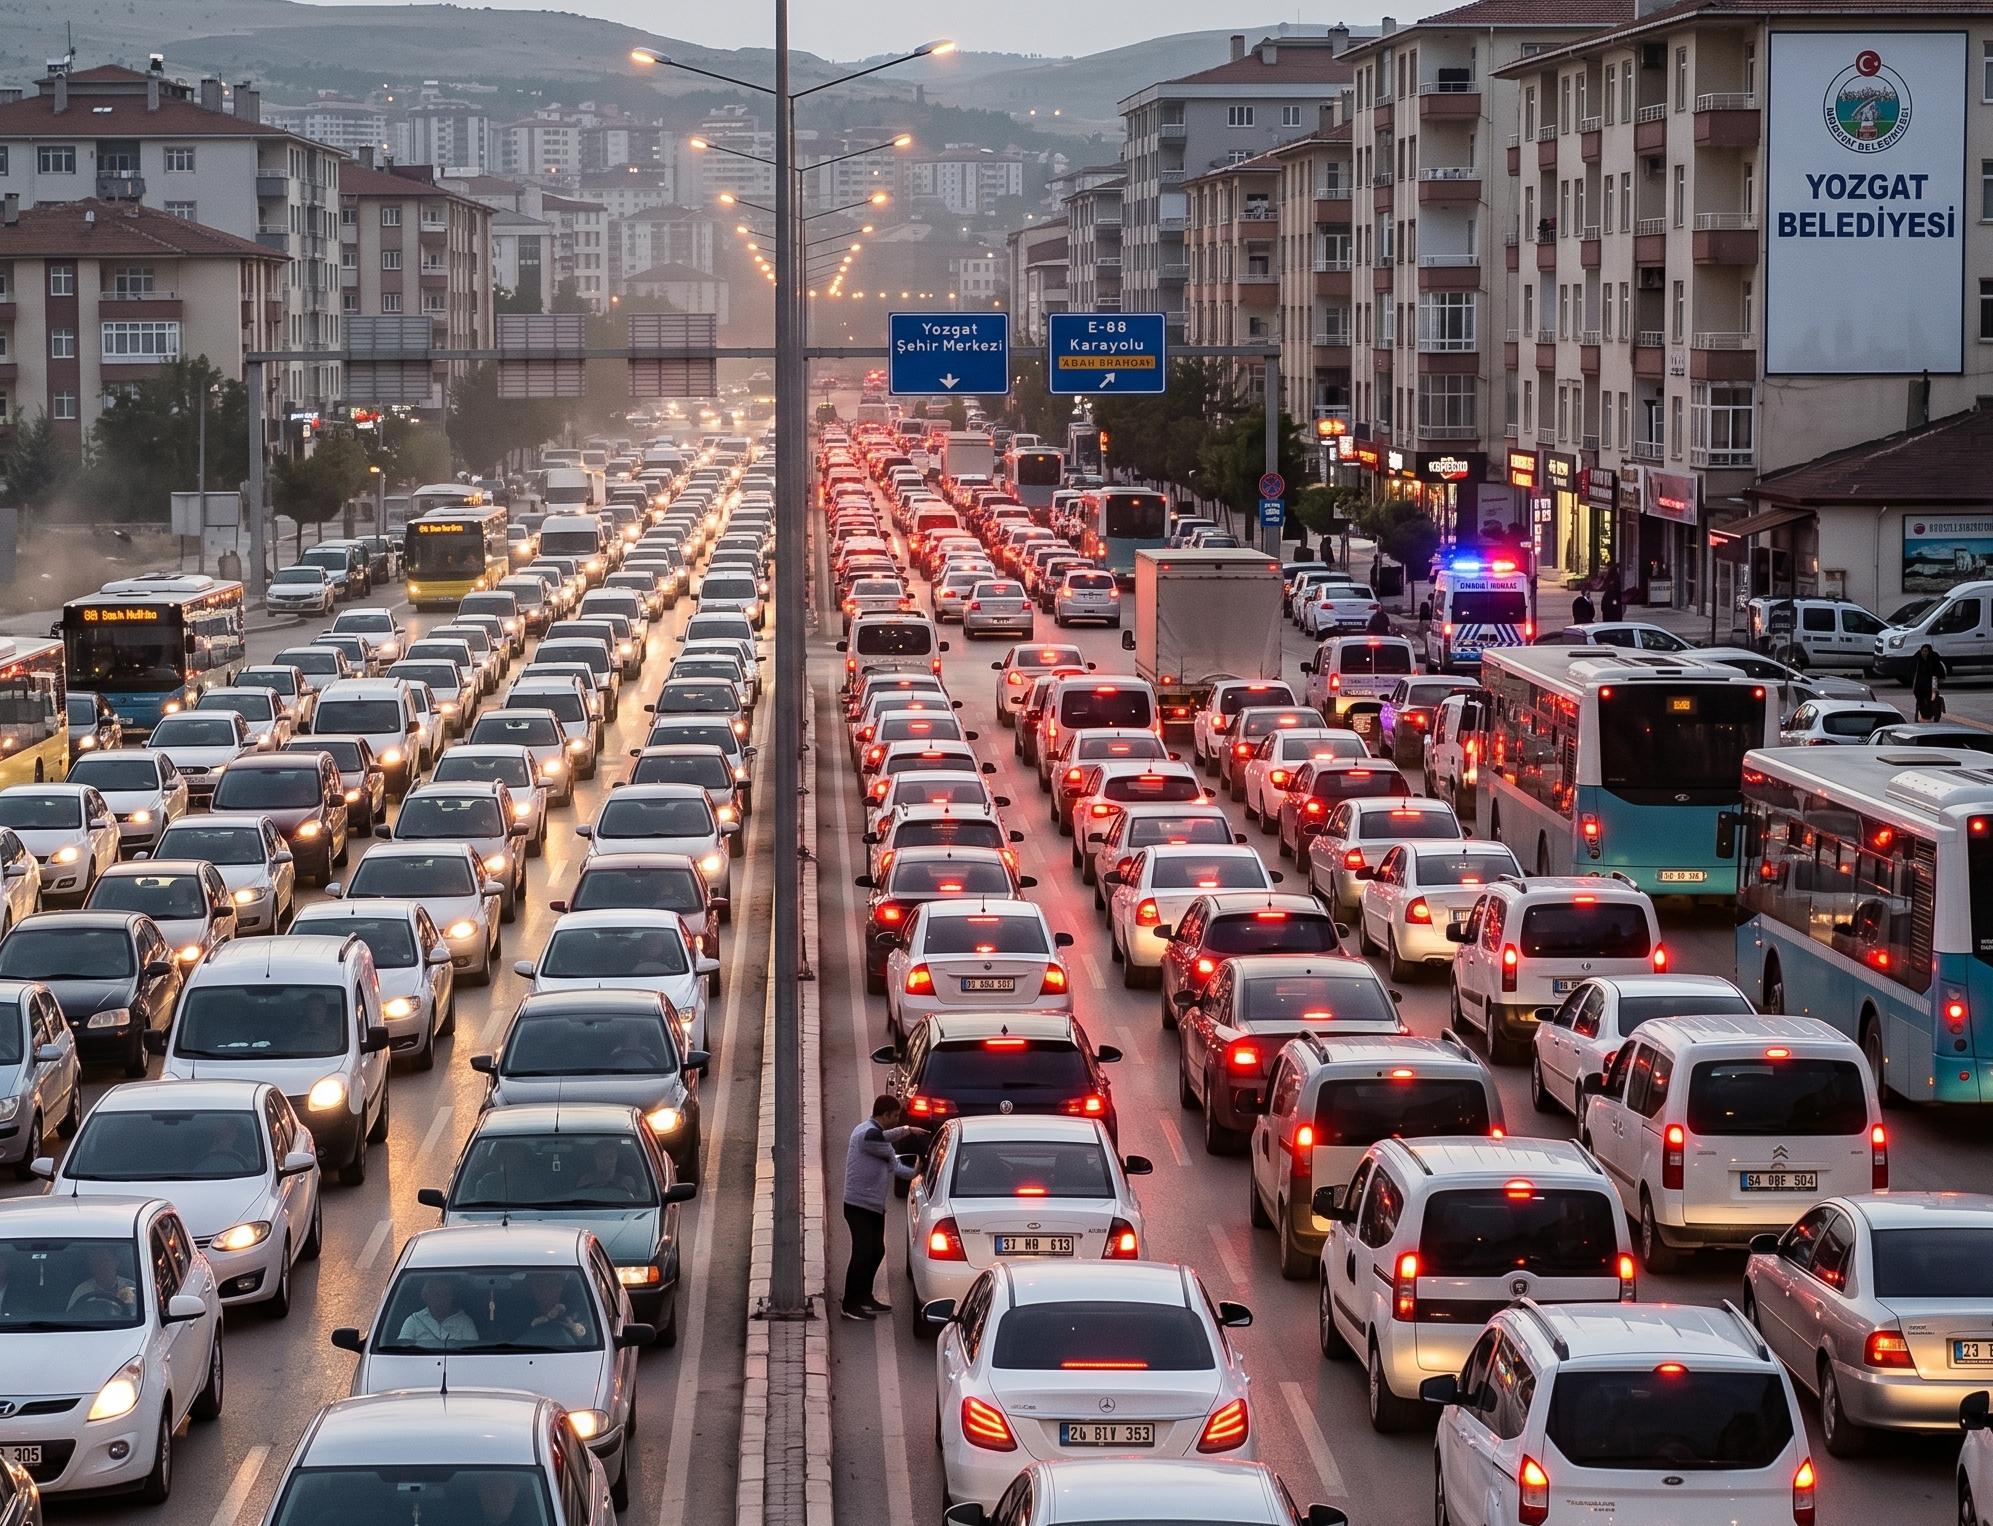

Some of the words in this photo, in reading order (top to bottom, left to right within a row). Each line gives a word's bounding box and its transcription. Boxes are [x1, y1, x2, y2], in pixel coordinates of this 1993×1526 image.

[1805, 174, 1929, 200] YOZGAT
[1778, 205, 1955, 238] BELEDİYESİ
[922, 322, 978, 339] Yozgat
[1088, 321, 1127, 333] E-88
[897, 339, 939, 354] Şehir
[943, 339, 1003, 352] Merkezi
[1070, 338, 1144, 353] Karayolu
[1051, 1238, 1070, 1250] 613
[1963, 1343, 1979, 1358] 23
[1094, 1426, 1117, 1441] BIV
[1125, 1426, 1150, 1441] 353
[14, 1447, 40, 1462] 305
